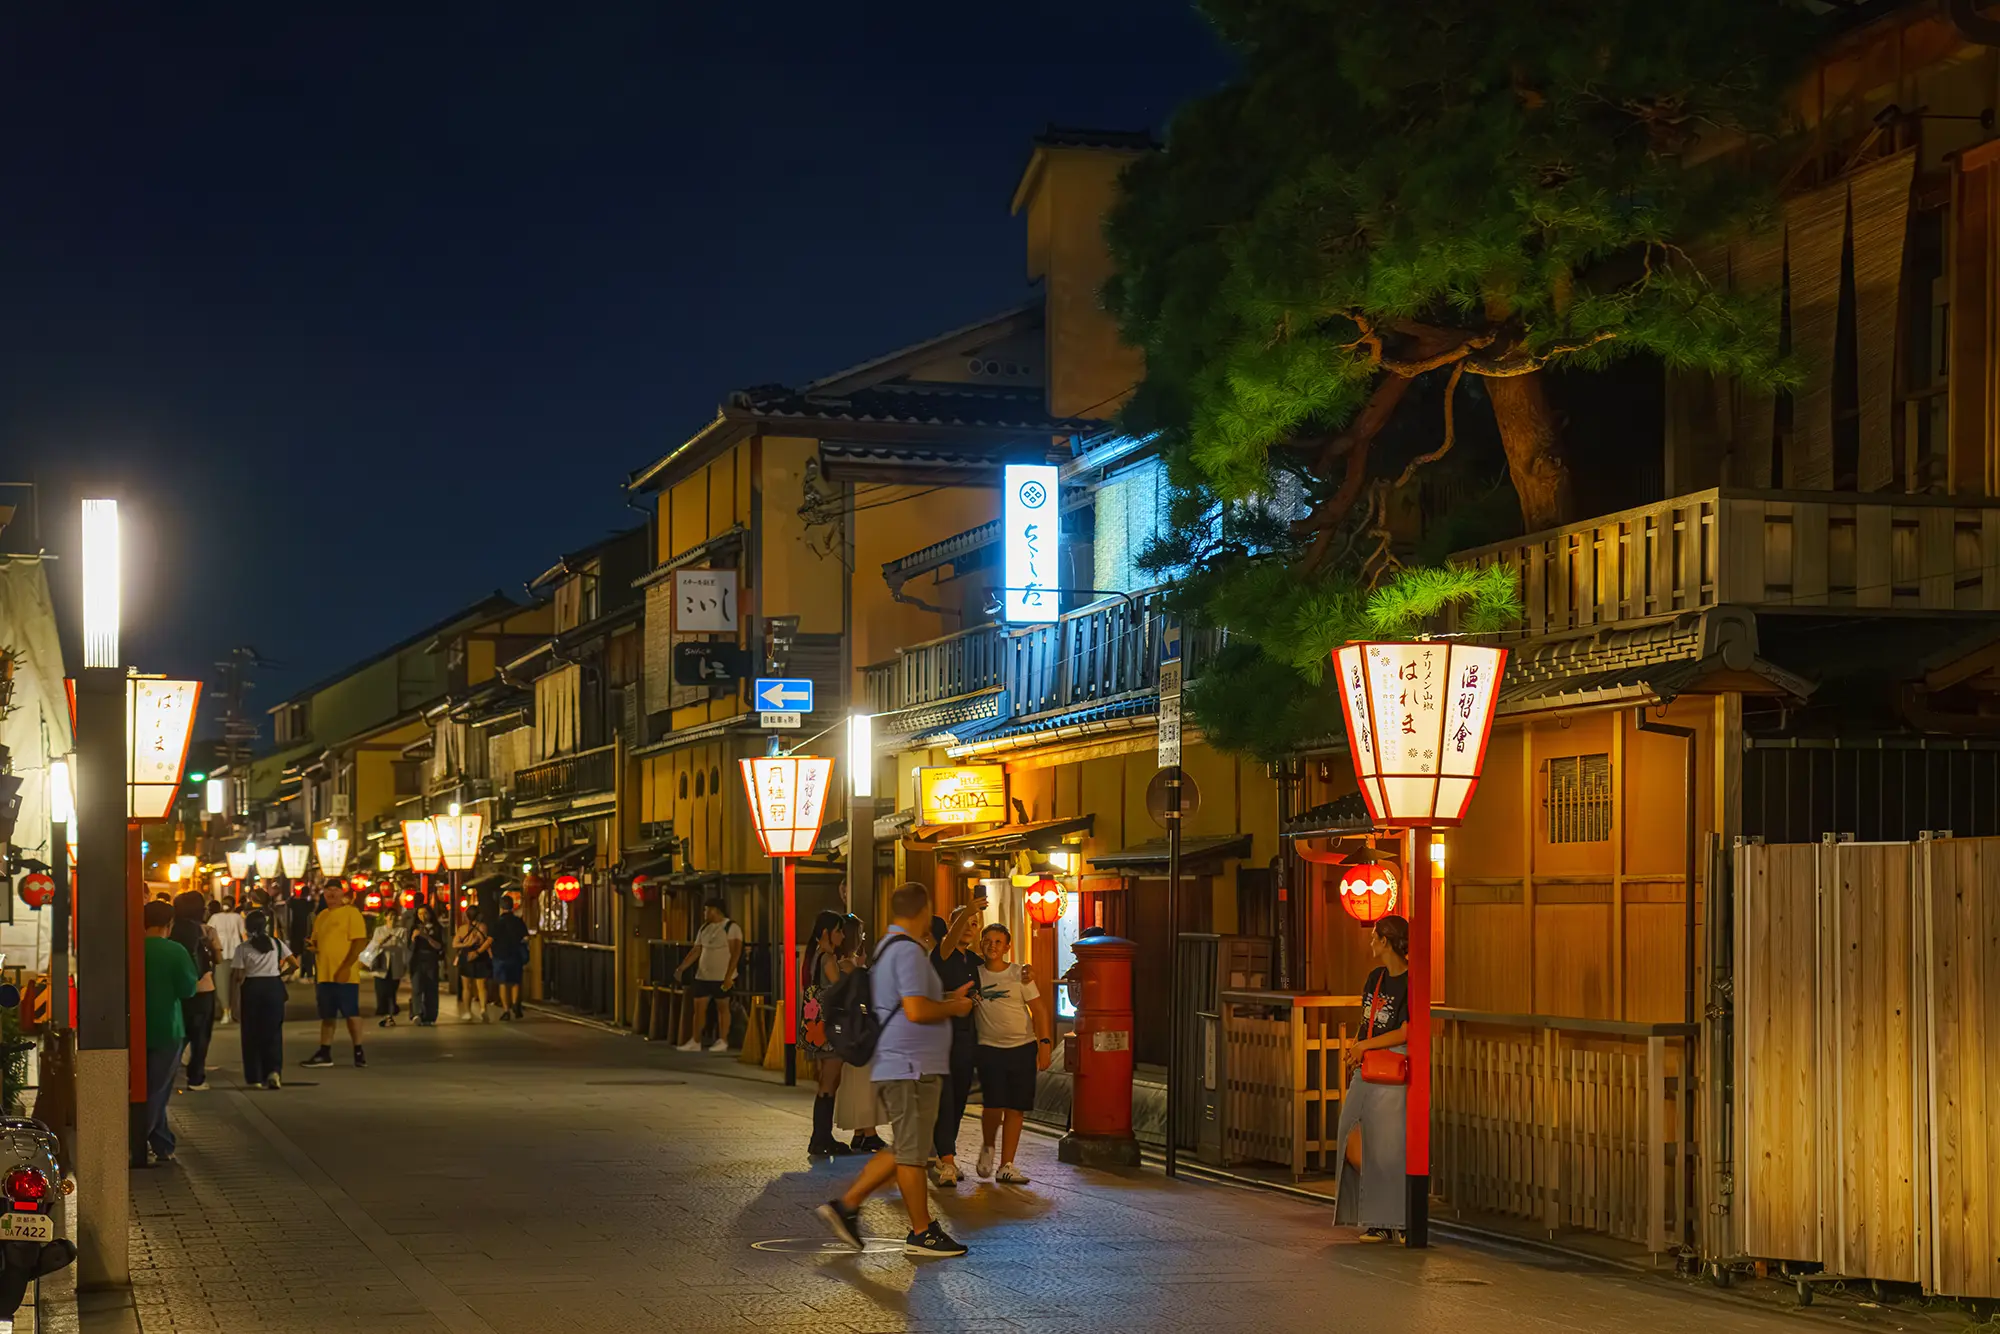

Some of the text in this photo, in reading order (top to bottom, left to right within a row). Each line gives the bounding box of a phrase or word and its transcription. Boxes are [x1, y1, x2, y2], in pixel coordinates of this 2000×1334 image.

[686, 588, 731, 622] こいし
[1398, 660, 1420, 735] はれま
[1423, 650, 1434, 711] チリメン山椒
[934, 791, 989, 809] YOSHIDA
[14, 1225, 46, 1238] 7422
